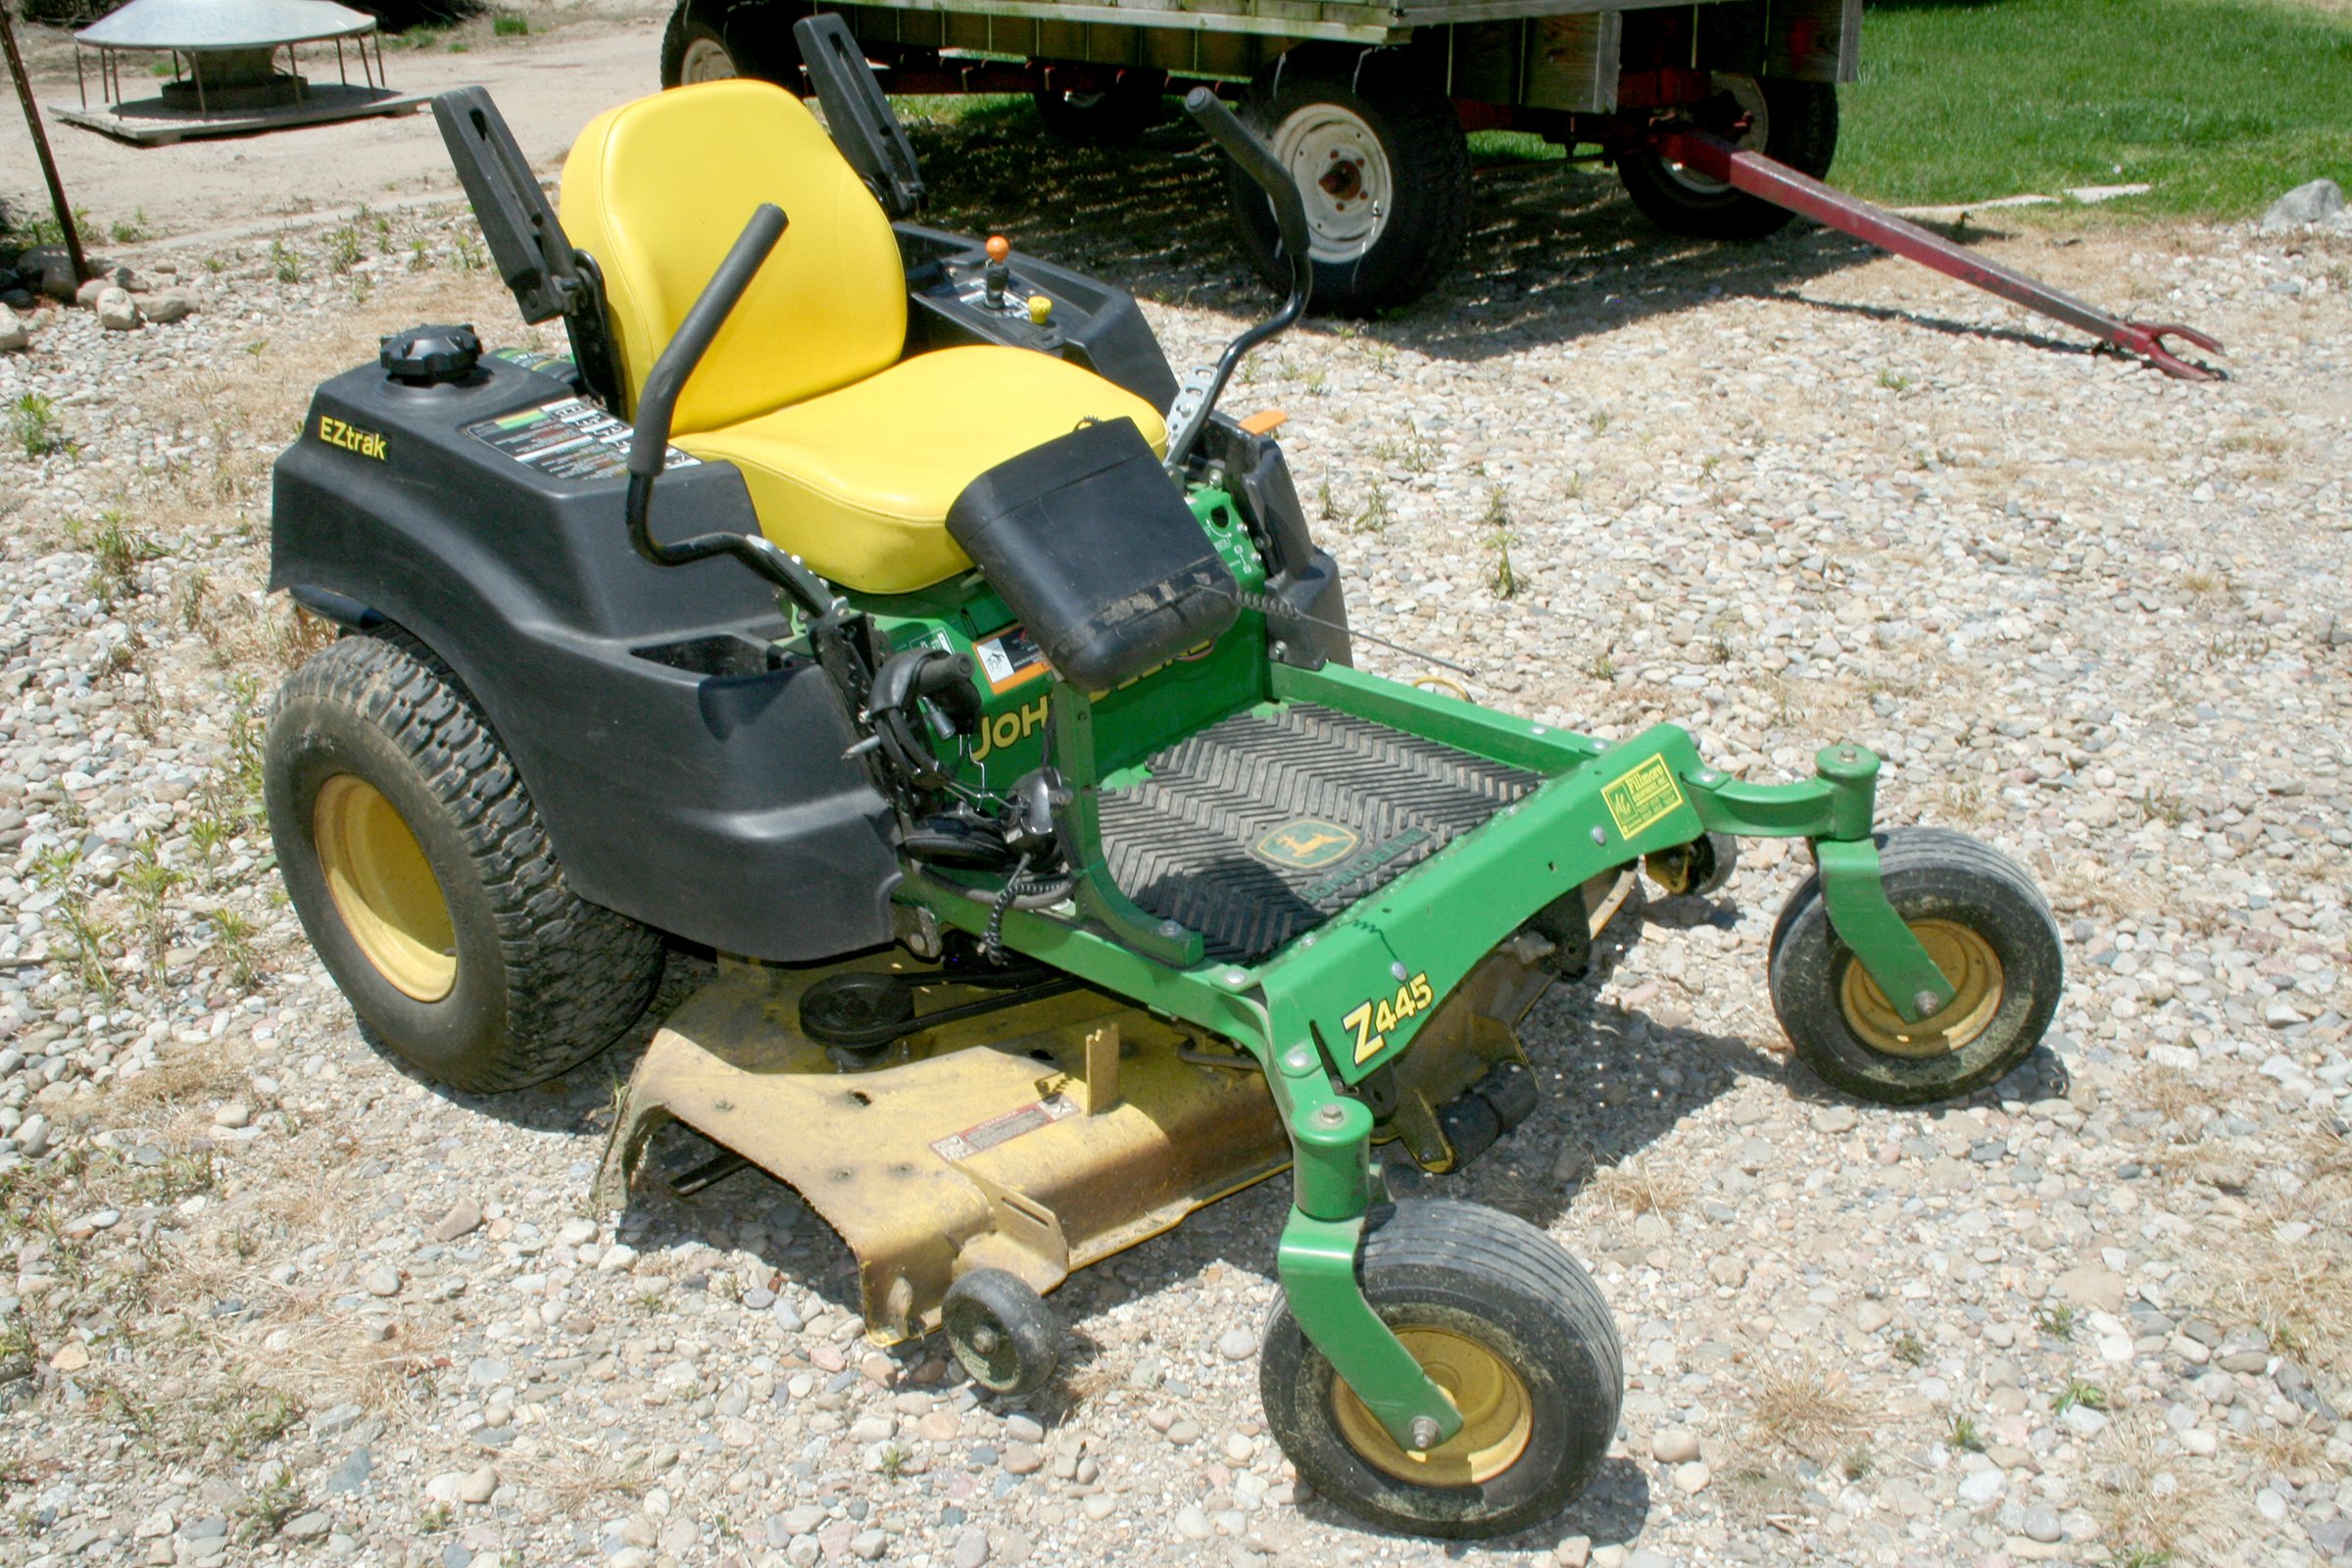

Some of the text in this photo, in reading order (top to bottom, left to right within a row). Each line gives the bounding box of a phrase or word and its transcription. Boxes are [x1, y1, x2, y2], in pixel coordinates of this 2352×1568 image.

[319, 415, 386, 461] EZtrak
[970, 694, 1055, 762] JOH
[1341, 970, 1434, 1067] Z445
